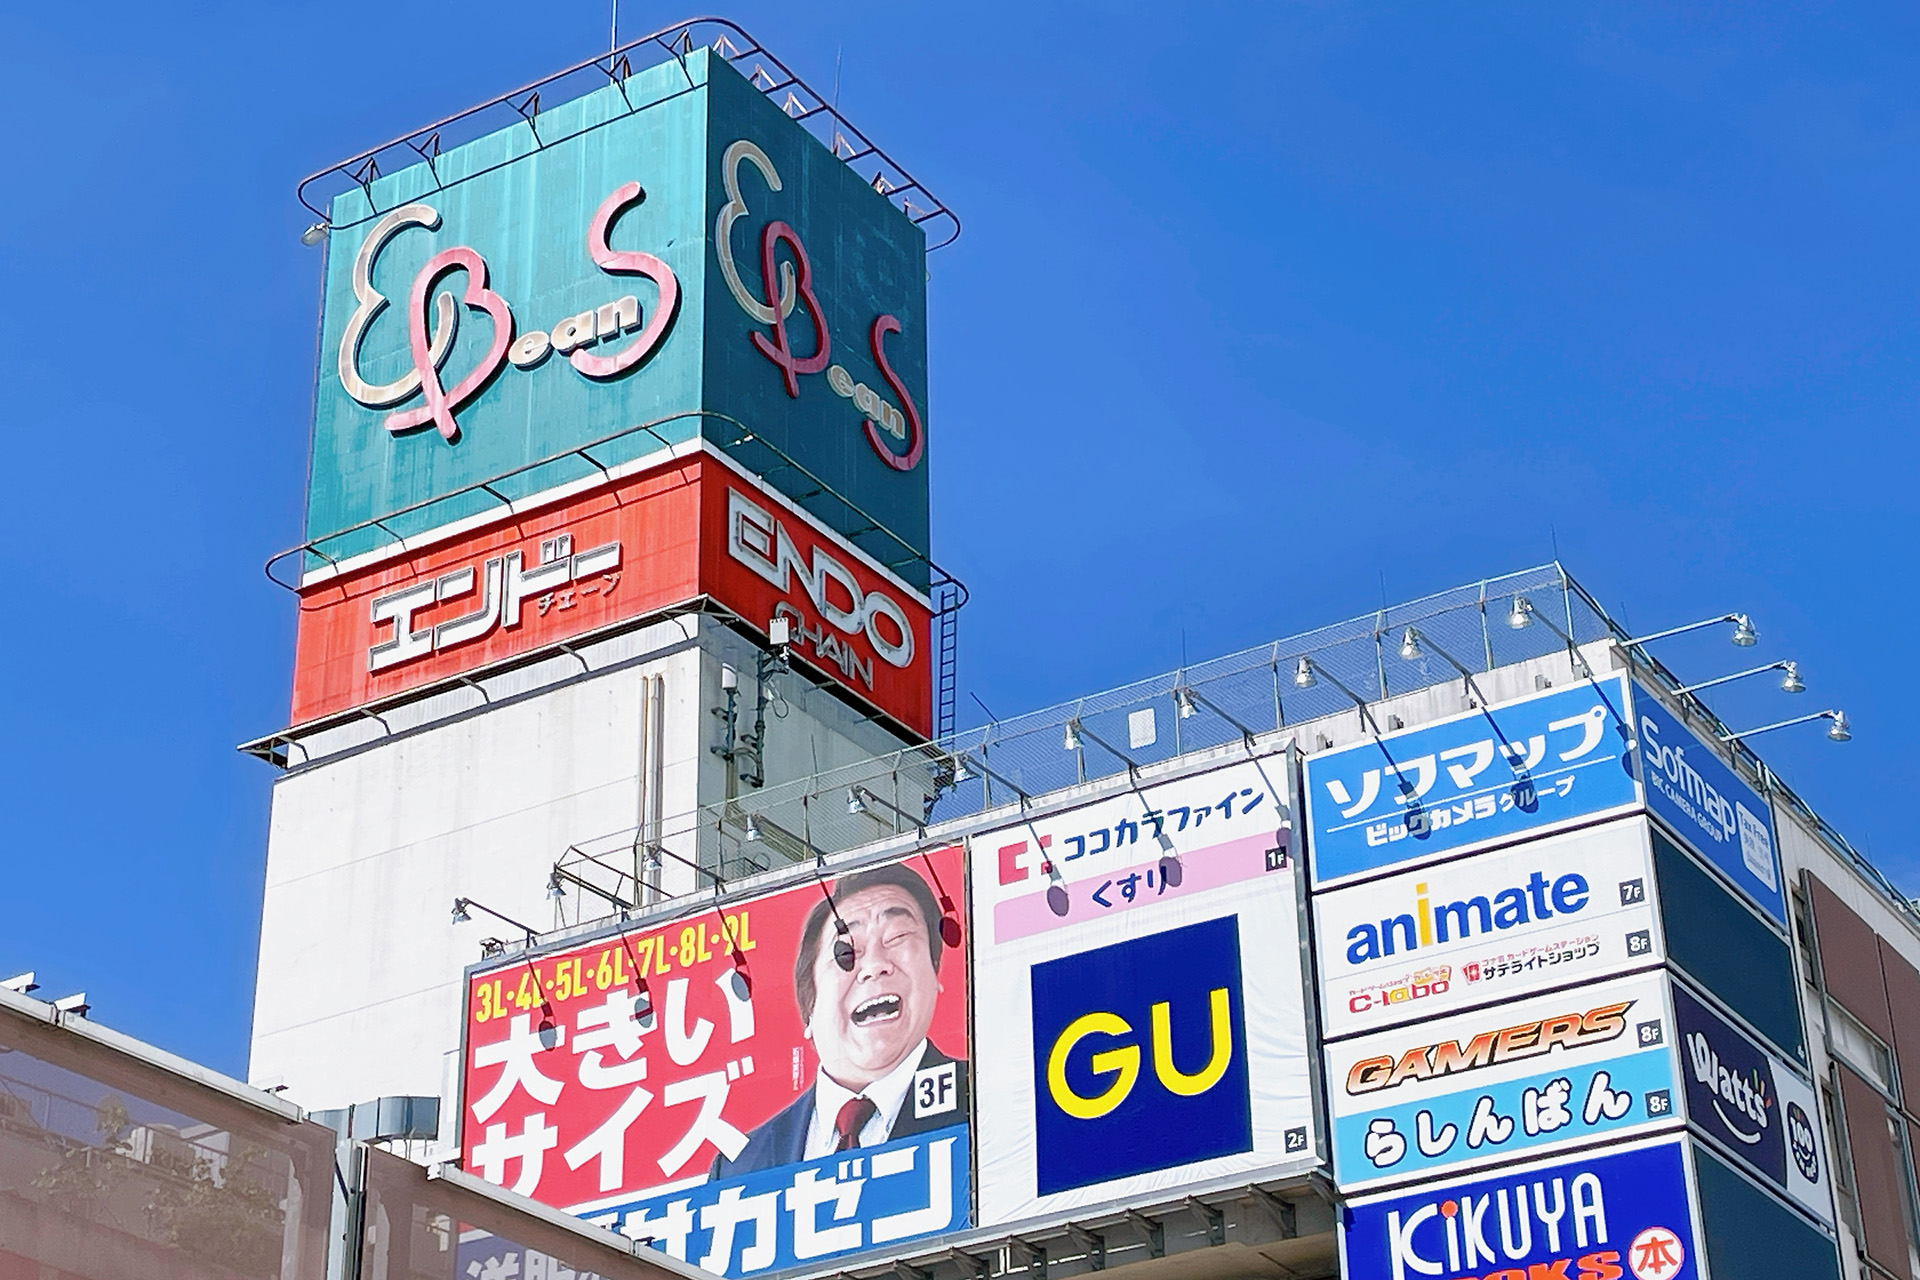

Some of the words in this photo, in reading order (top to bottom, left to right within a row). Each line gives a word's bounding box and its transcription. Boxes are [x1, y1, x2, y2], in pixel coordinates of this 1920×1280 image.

[368, 534, 621, 671] エンドー
[728, 486, 916, 668] ENDO
[1325, 705, 1607, 819] ソフマップ
[1641, 715, 1736, 843] Sofmap
[1064, 788, 1264, 861] ココカラファイン
[1091, 865, 1168, 908] くすり
[1346, 871, 1590, 965] animate
[1622, 884, 1641, 901] 7F
[1629, 935, 1648, 952] 8F
[472, 967, 757, 1124] 大きい
[1046, 987, 1233, 1120] GU
[1346, 999, 1639, 1096] GAMERS
[1640, 1026, 1660, 1042] 8F
[471, 1056, 756, 1198] サイズ
[919, 1071, 955, 1110] 3F
[1365, 1071, 1632, 1168] らしんばん
[1649, 1096, 1668, 1113] 8F
[1287, 1132, 1305, 1149] 2F
